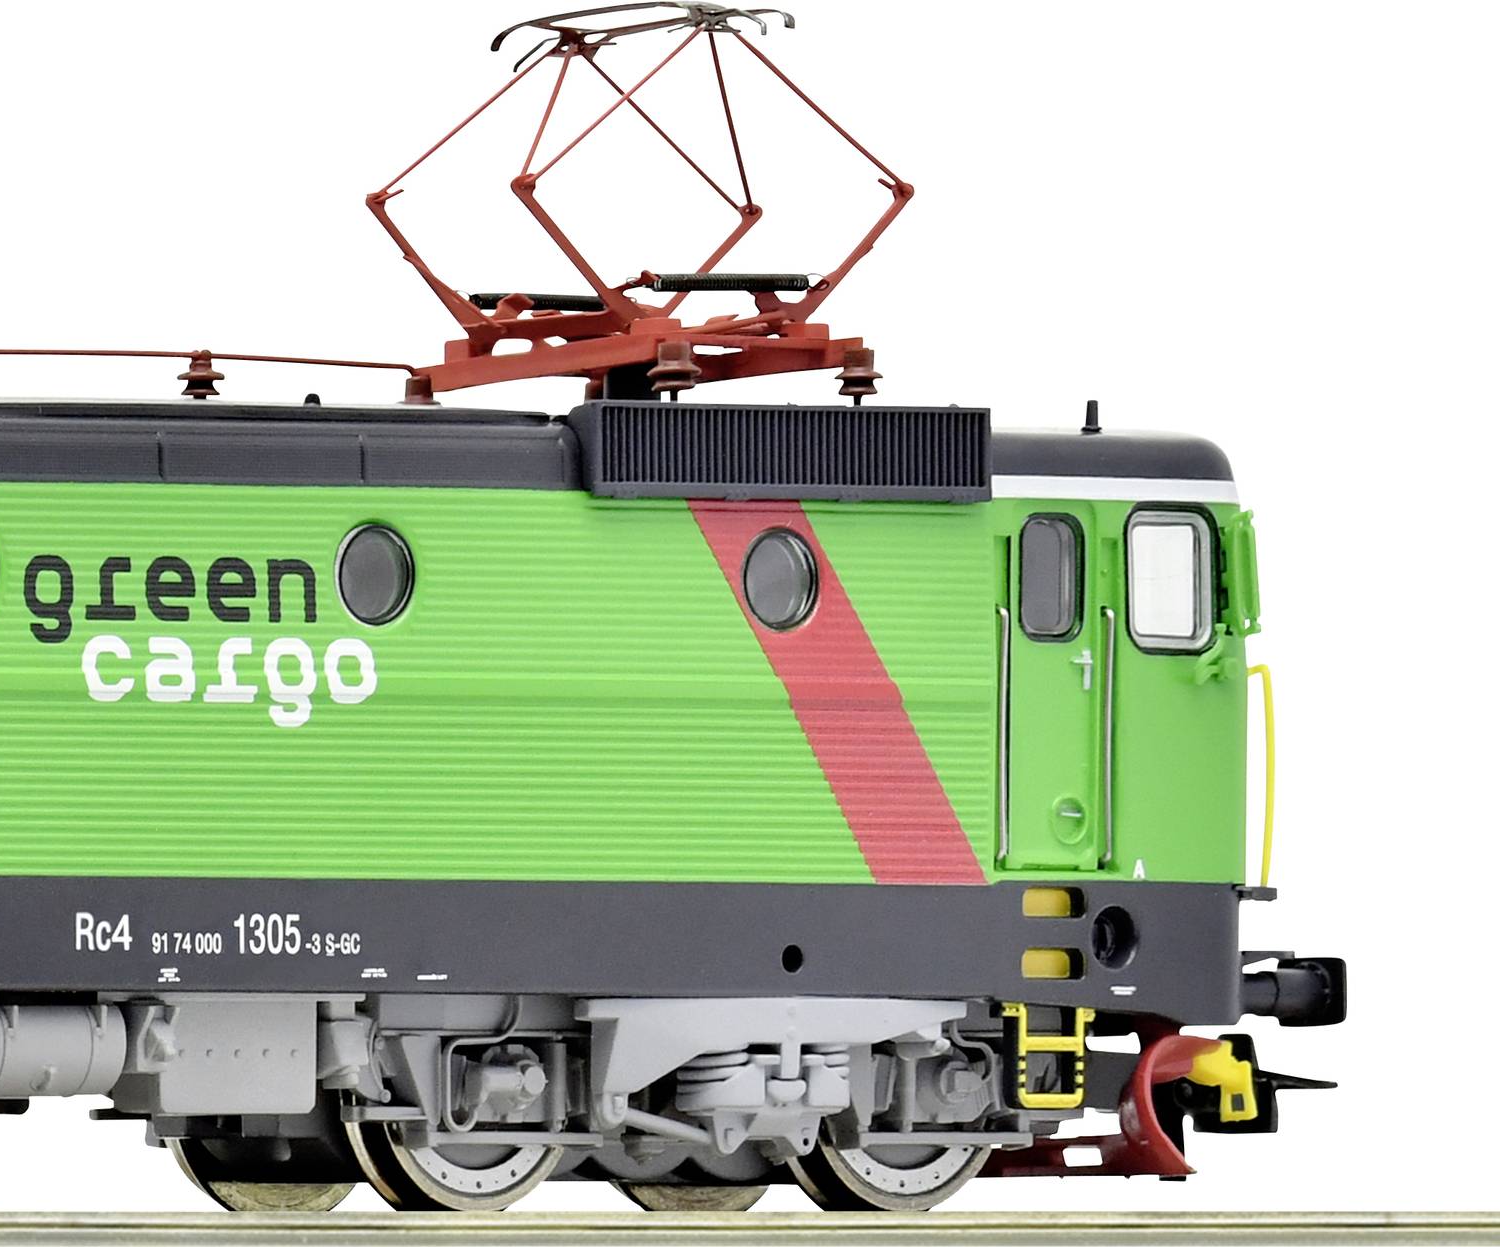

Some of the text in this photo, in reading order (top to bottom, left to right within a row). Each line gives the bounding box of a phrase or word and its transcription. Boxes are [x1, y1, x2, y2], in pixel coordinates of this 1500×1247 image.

[23, 554, 318, 644] green
[81, 635, 378, 728] cargo
[1133, 859, 1145, 879] A
[75, 912, 133, 951] Rc4
[151, 933, 168, 953] 91
[173, 933, 191, 953] 74
[195, 933, 222, 954] 000
[234, 913, 301, 954] 1305
